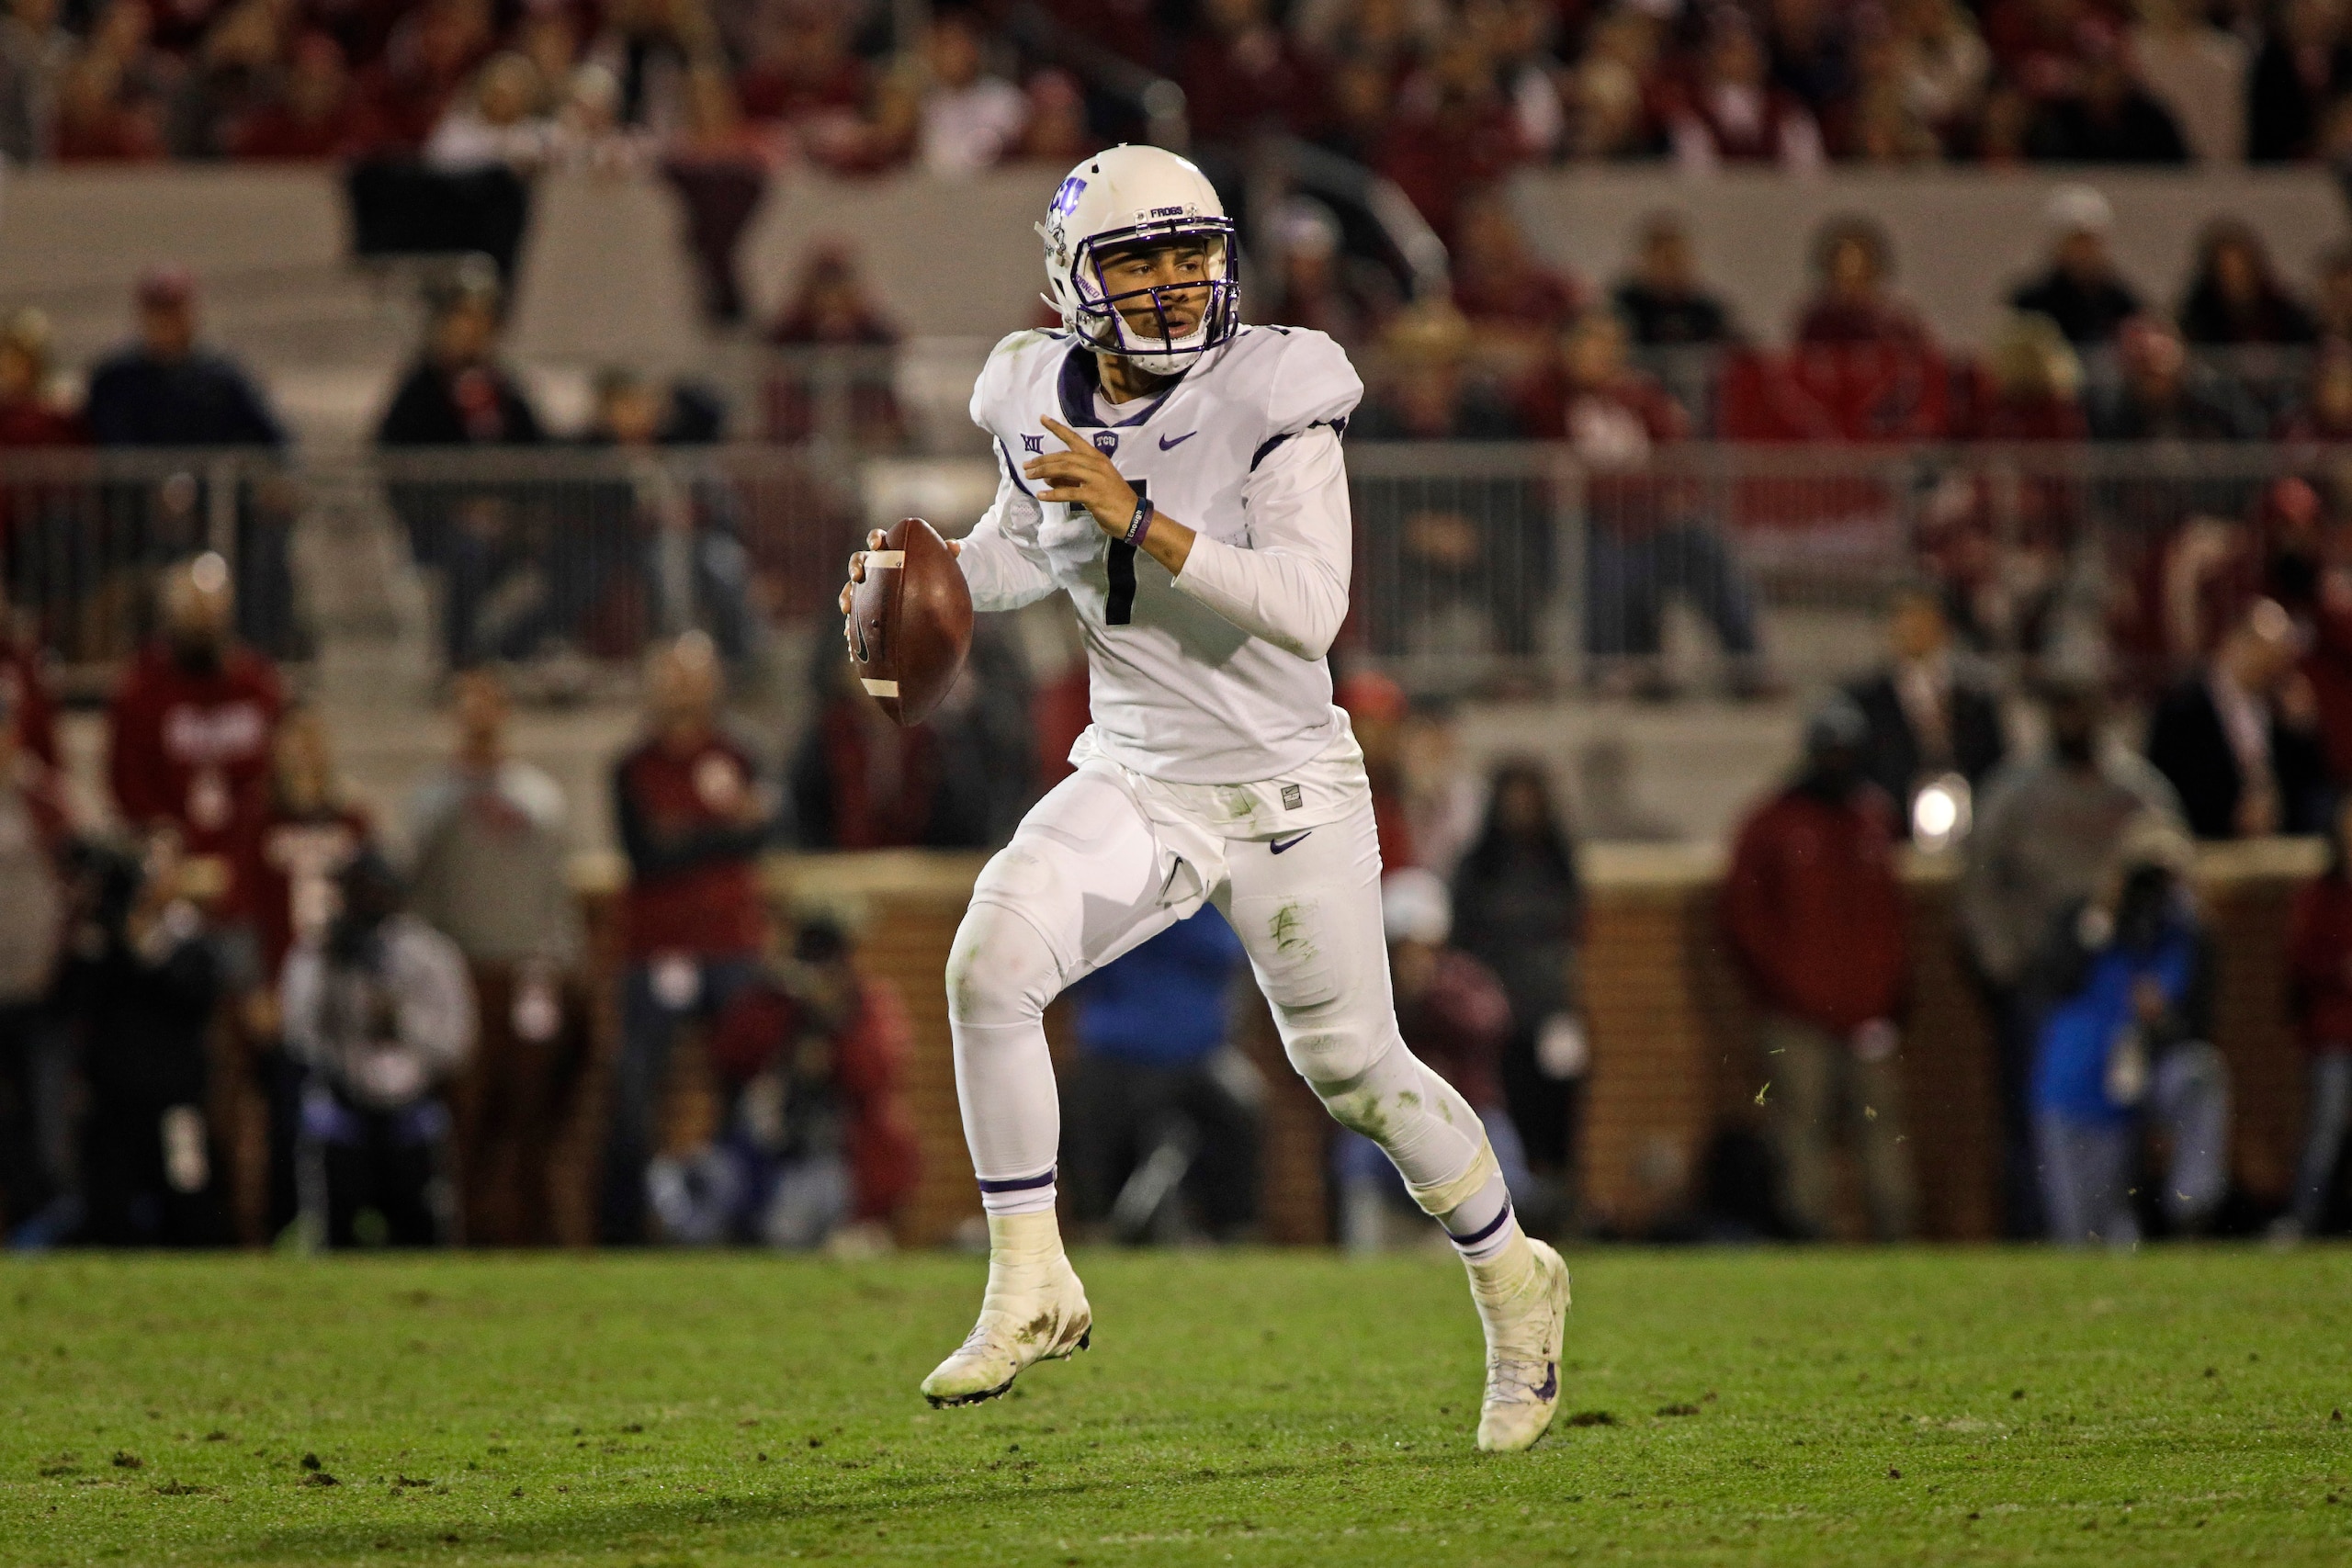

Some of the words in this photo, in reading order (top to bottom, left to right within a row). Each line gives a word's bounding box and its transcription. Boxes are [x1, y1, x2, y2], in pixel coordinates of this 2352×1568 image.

[1150, 206, 1182, 218] FROGS
[1021, 433, 1045, 455] XII
[1096, 435, 1115, 447] TCU
[1126, 509, 1143, 538] Enough
